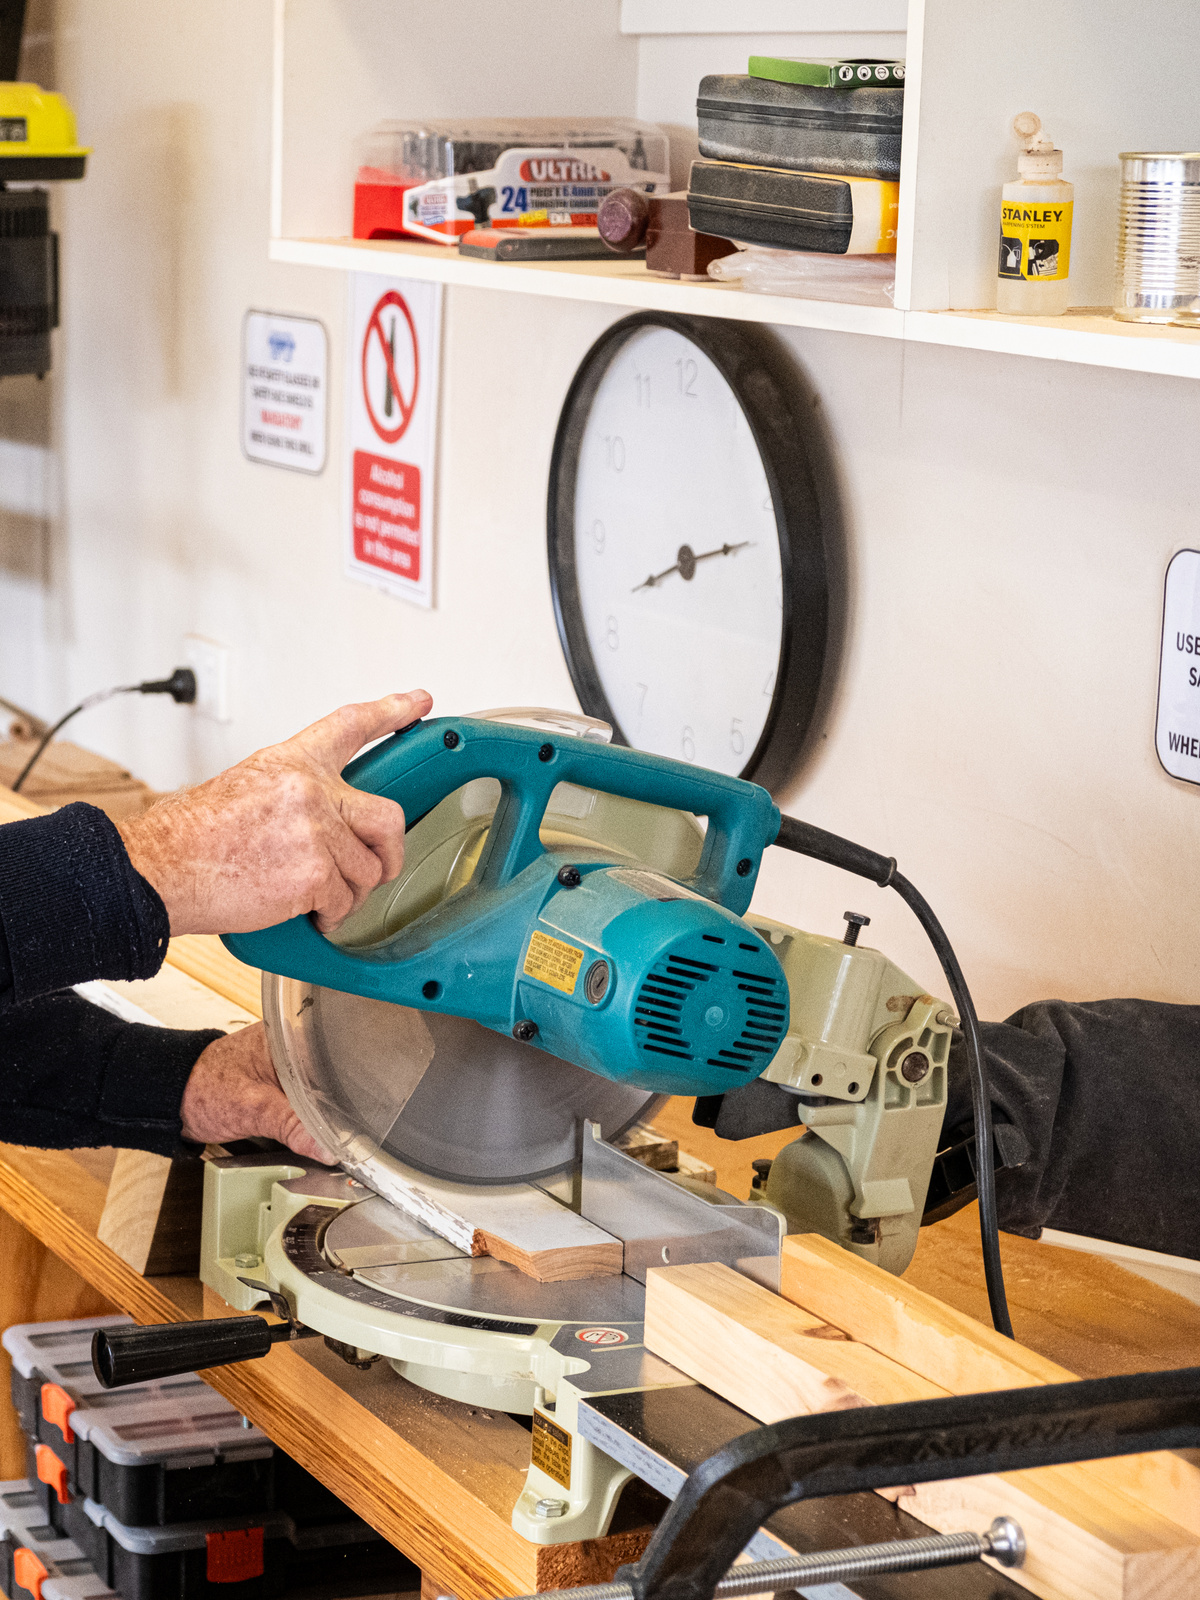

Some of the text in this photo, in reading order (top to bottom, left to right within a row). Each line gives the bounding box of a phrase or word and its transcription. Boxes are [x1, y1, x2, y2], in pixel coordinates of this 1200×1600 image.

[530, 160, 598, 180] ULTRA
[501, 186, 528, 213] 24
[1002, 208, 1063, 222] STANLEY
[634, 372, 651, 409] 11
[675, 358, 698, 398] 12
[604, 435, 626, 472] 10
[370, 463, 404, 490] Alcohol
[358, 488, 416, 519] consumption
[378, 520, 420, 548] permitted
[592, 519, 606, 554] 9
[606, 615, 620, 652] 8
[681, 725, 696, 762] 6
[730, 717, 744, 756] 5
[1169, 732, 1200, 758] WHE
